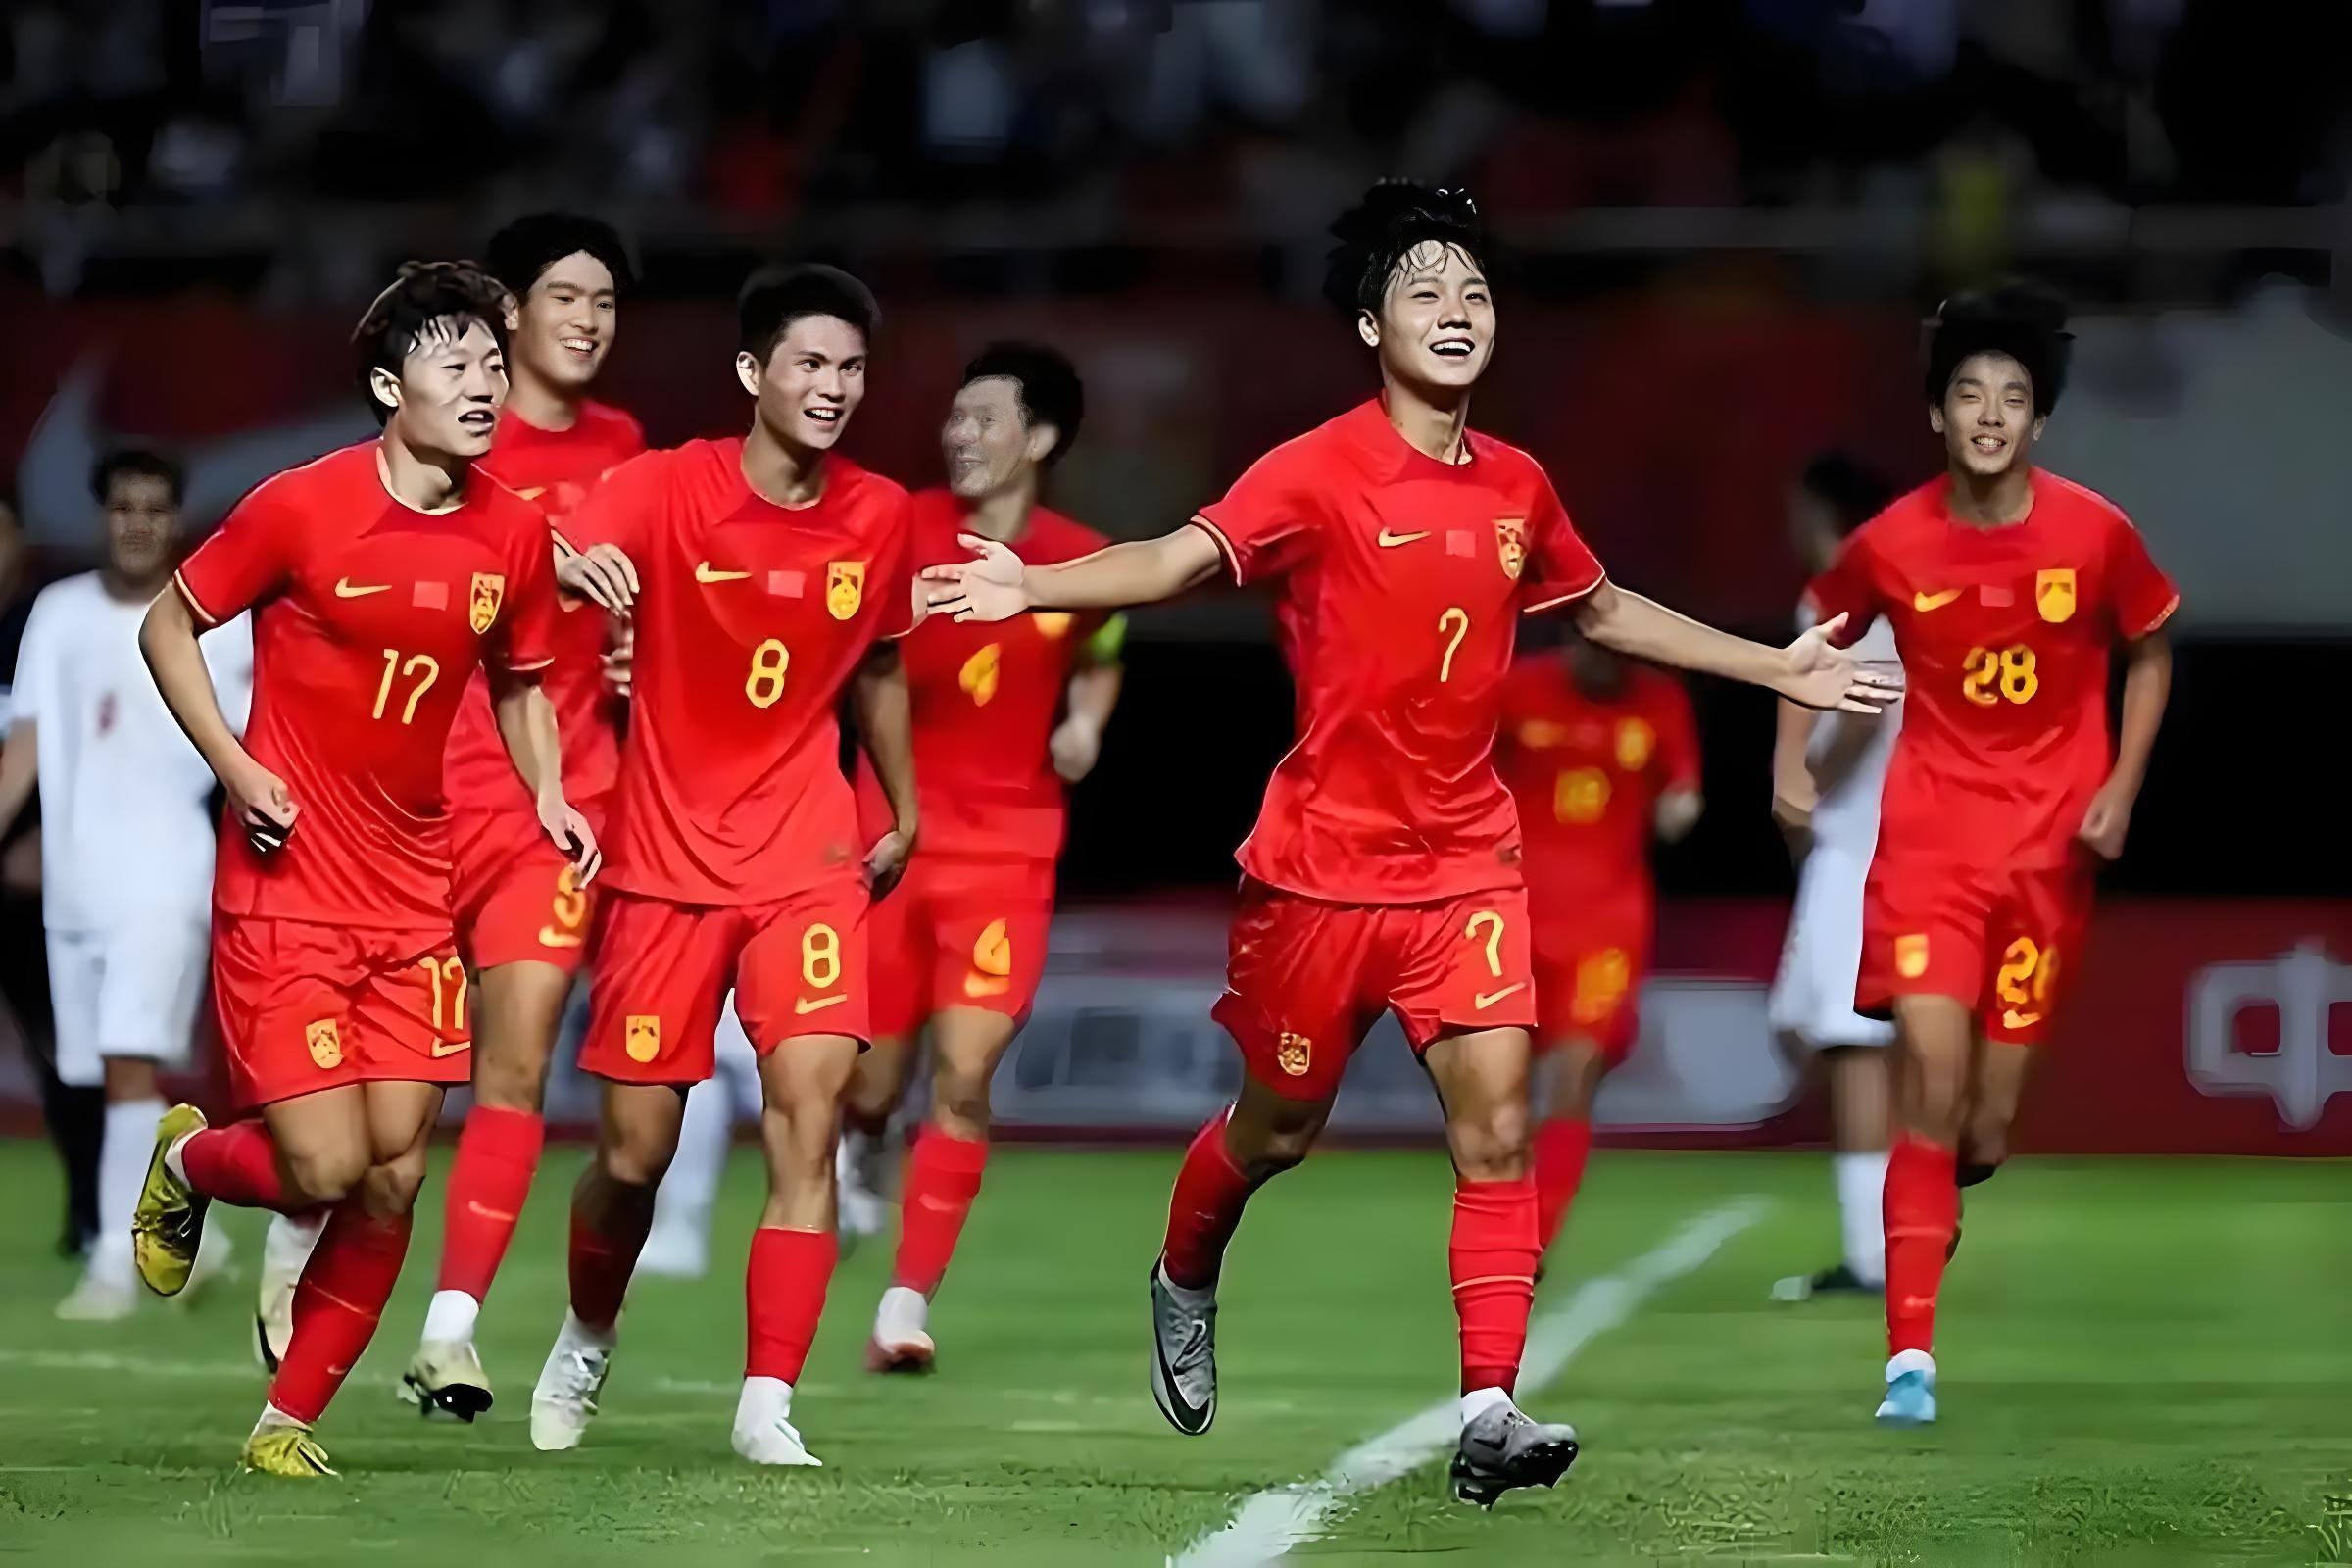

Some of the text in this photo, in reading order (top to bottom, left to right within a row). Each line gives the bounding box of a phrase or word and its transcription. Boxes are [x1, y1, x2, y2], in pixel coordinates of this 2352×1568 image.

[746, 638, 790, 708] 8
[1439, 608, 1468, 682] 7
[1962, 644, 2038, 706] 28
[372, 648, 439, 724] 17
[802, 923, 840, 988] 8
[1465, 911, 1504, 977] 7
[417, 956, 467, 1029] 17
[2182, 935, 2352, 1131] 中
